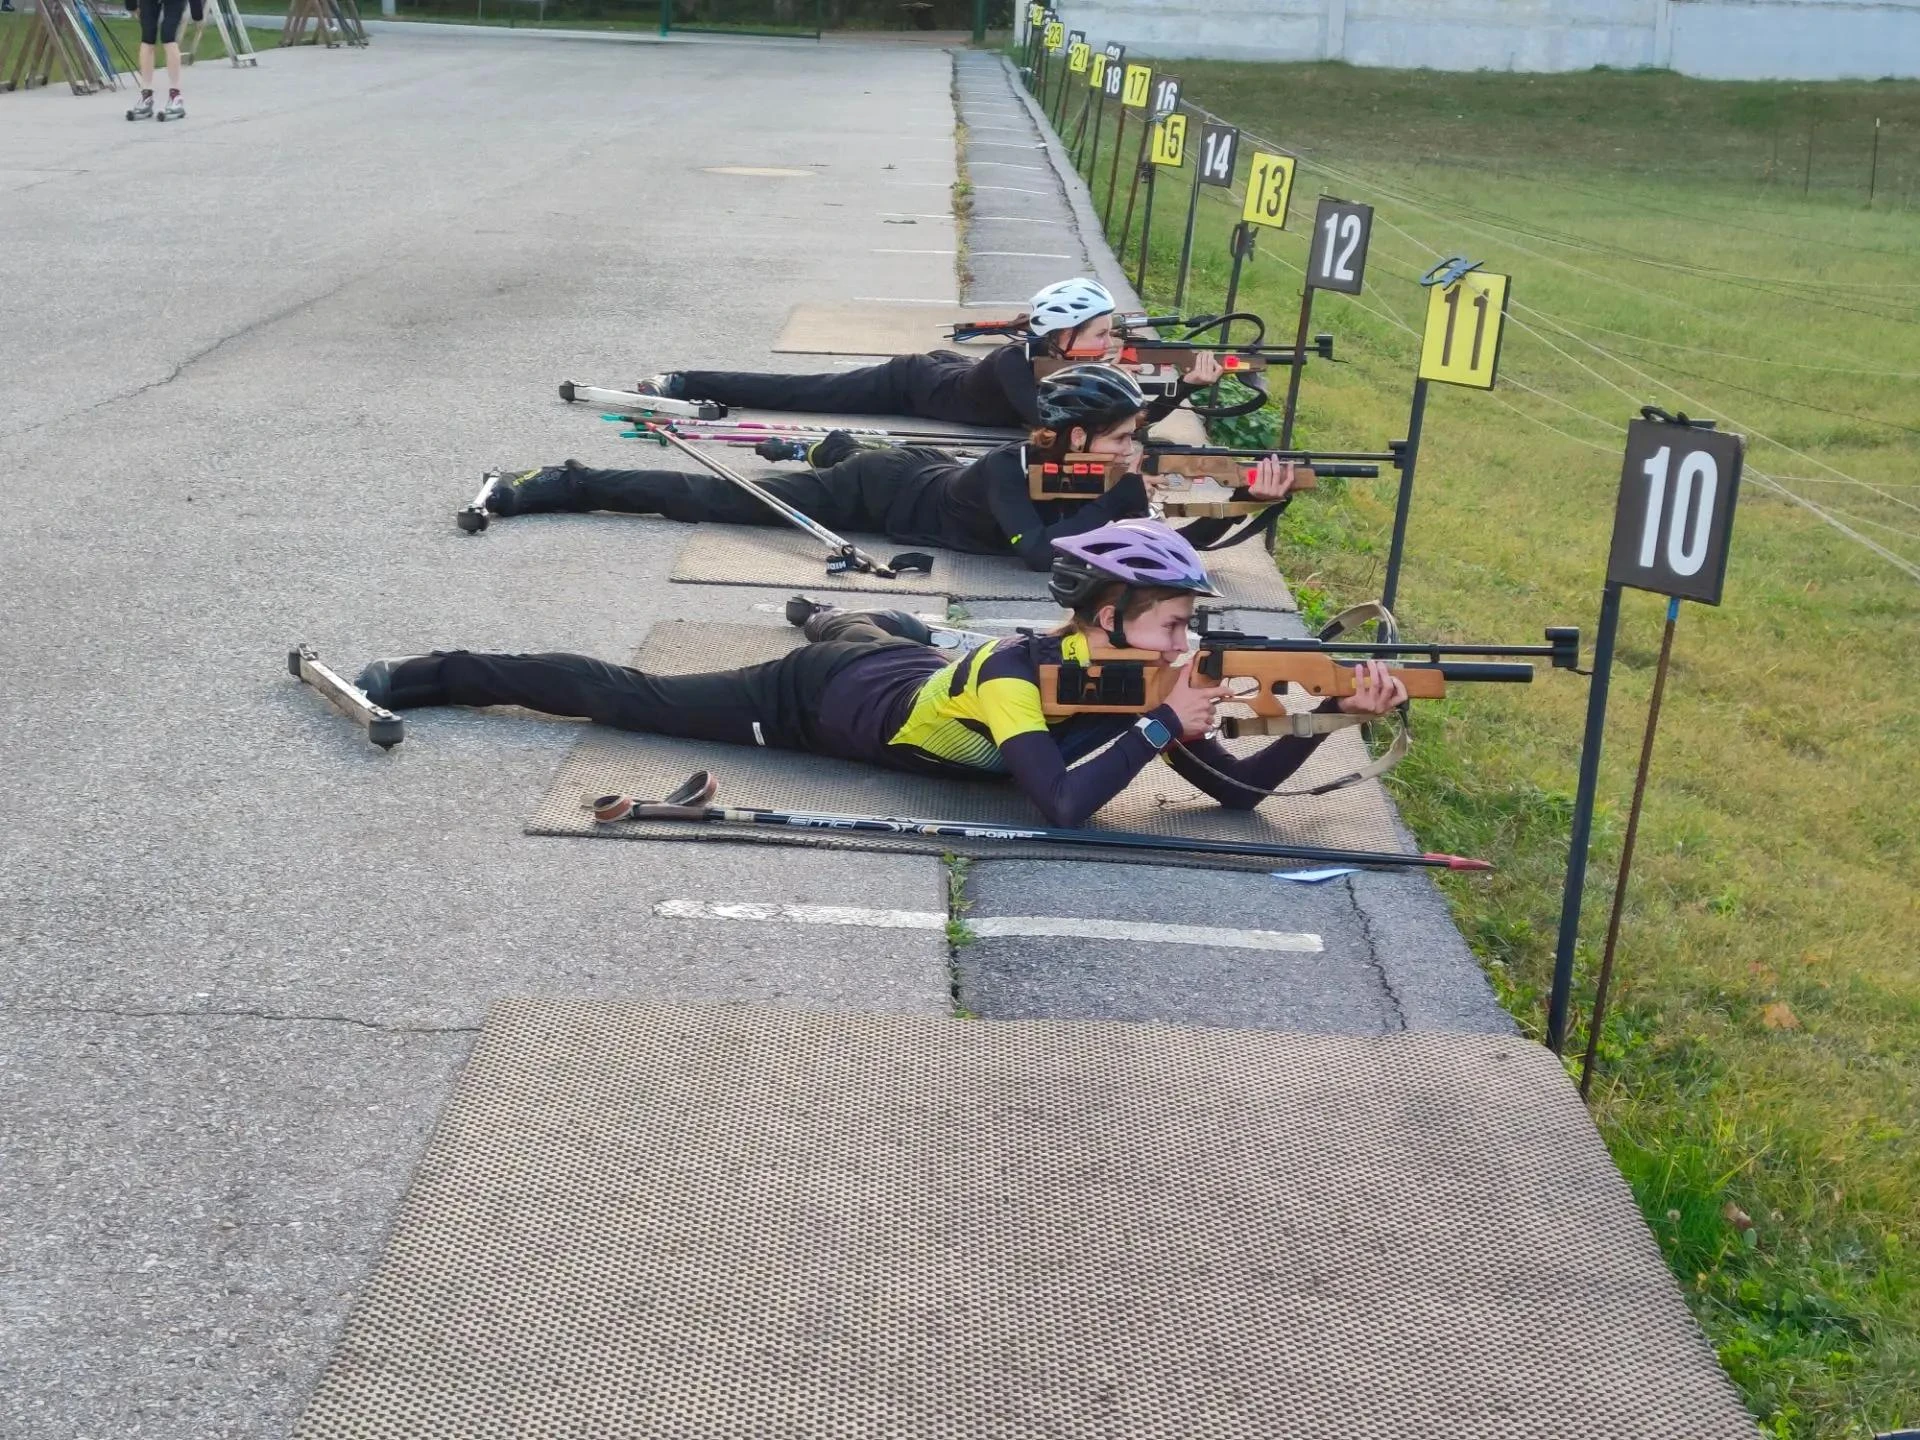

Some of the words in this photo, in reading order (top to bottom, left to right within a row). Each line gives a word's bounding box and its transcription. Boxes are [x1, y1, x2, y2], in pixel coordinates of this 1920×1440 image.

[1050, 26, 1061, 44] 23
[1073, 47, 1087, 67] 21
[1106, 66, 1121, 94] 18
[1130, 71, 1147, 101] 17
[1156, 81, 1178, 113] 16
[1161, 121, 1180, 158] 15
[1204, 131, 1232, 179] 14
[1256, 163, 1285, 218] 13
[1321, 212, 1361, 281] 12
[1441, 284, 1490, 371] 11
[1639, 446, 1719, 577] 10
